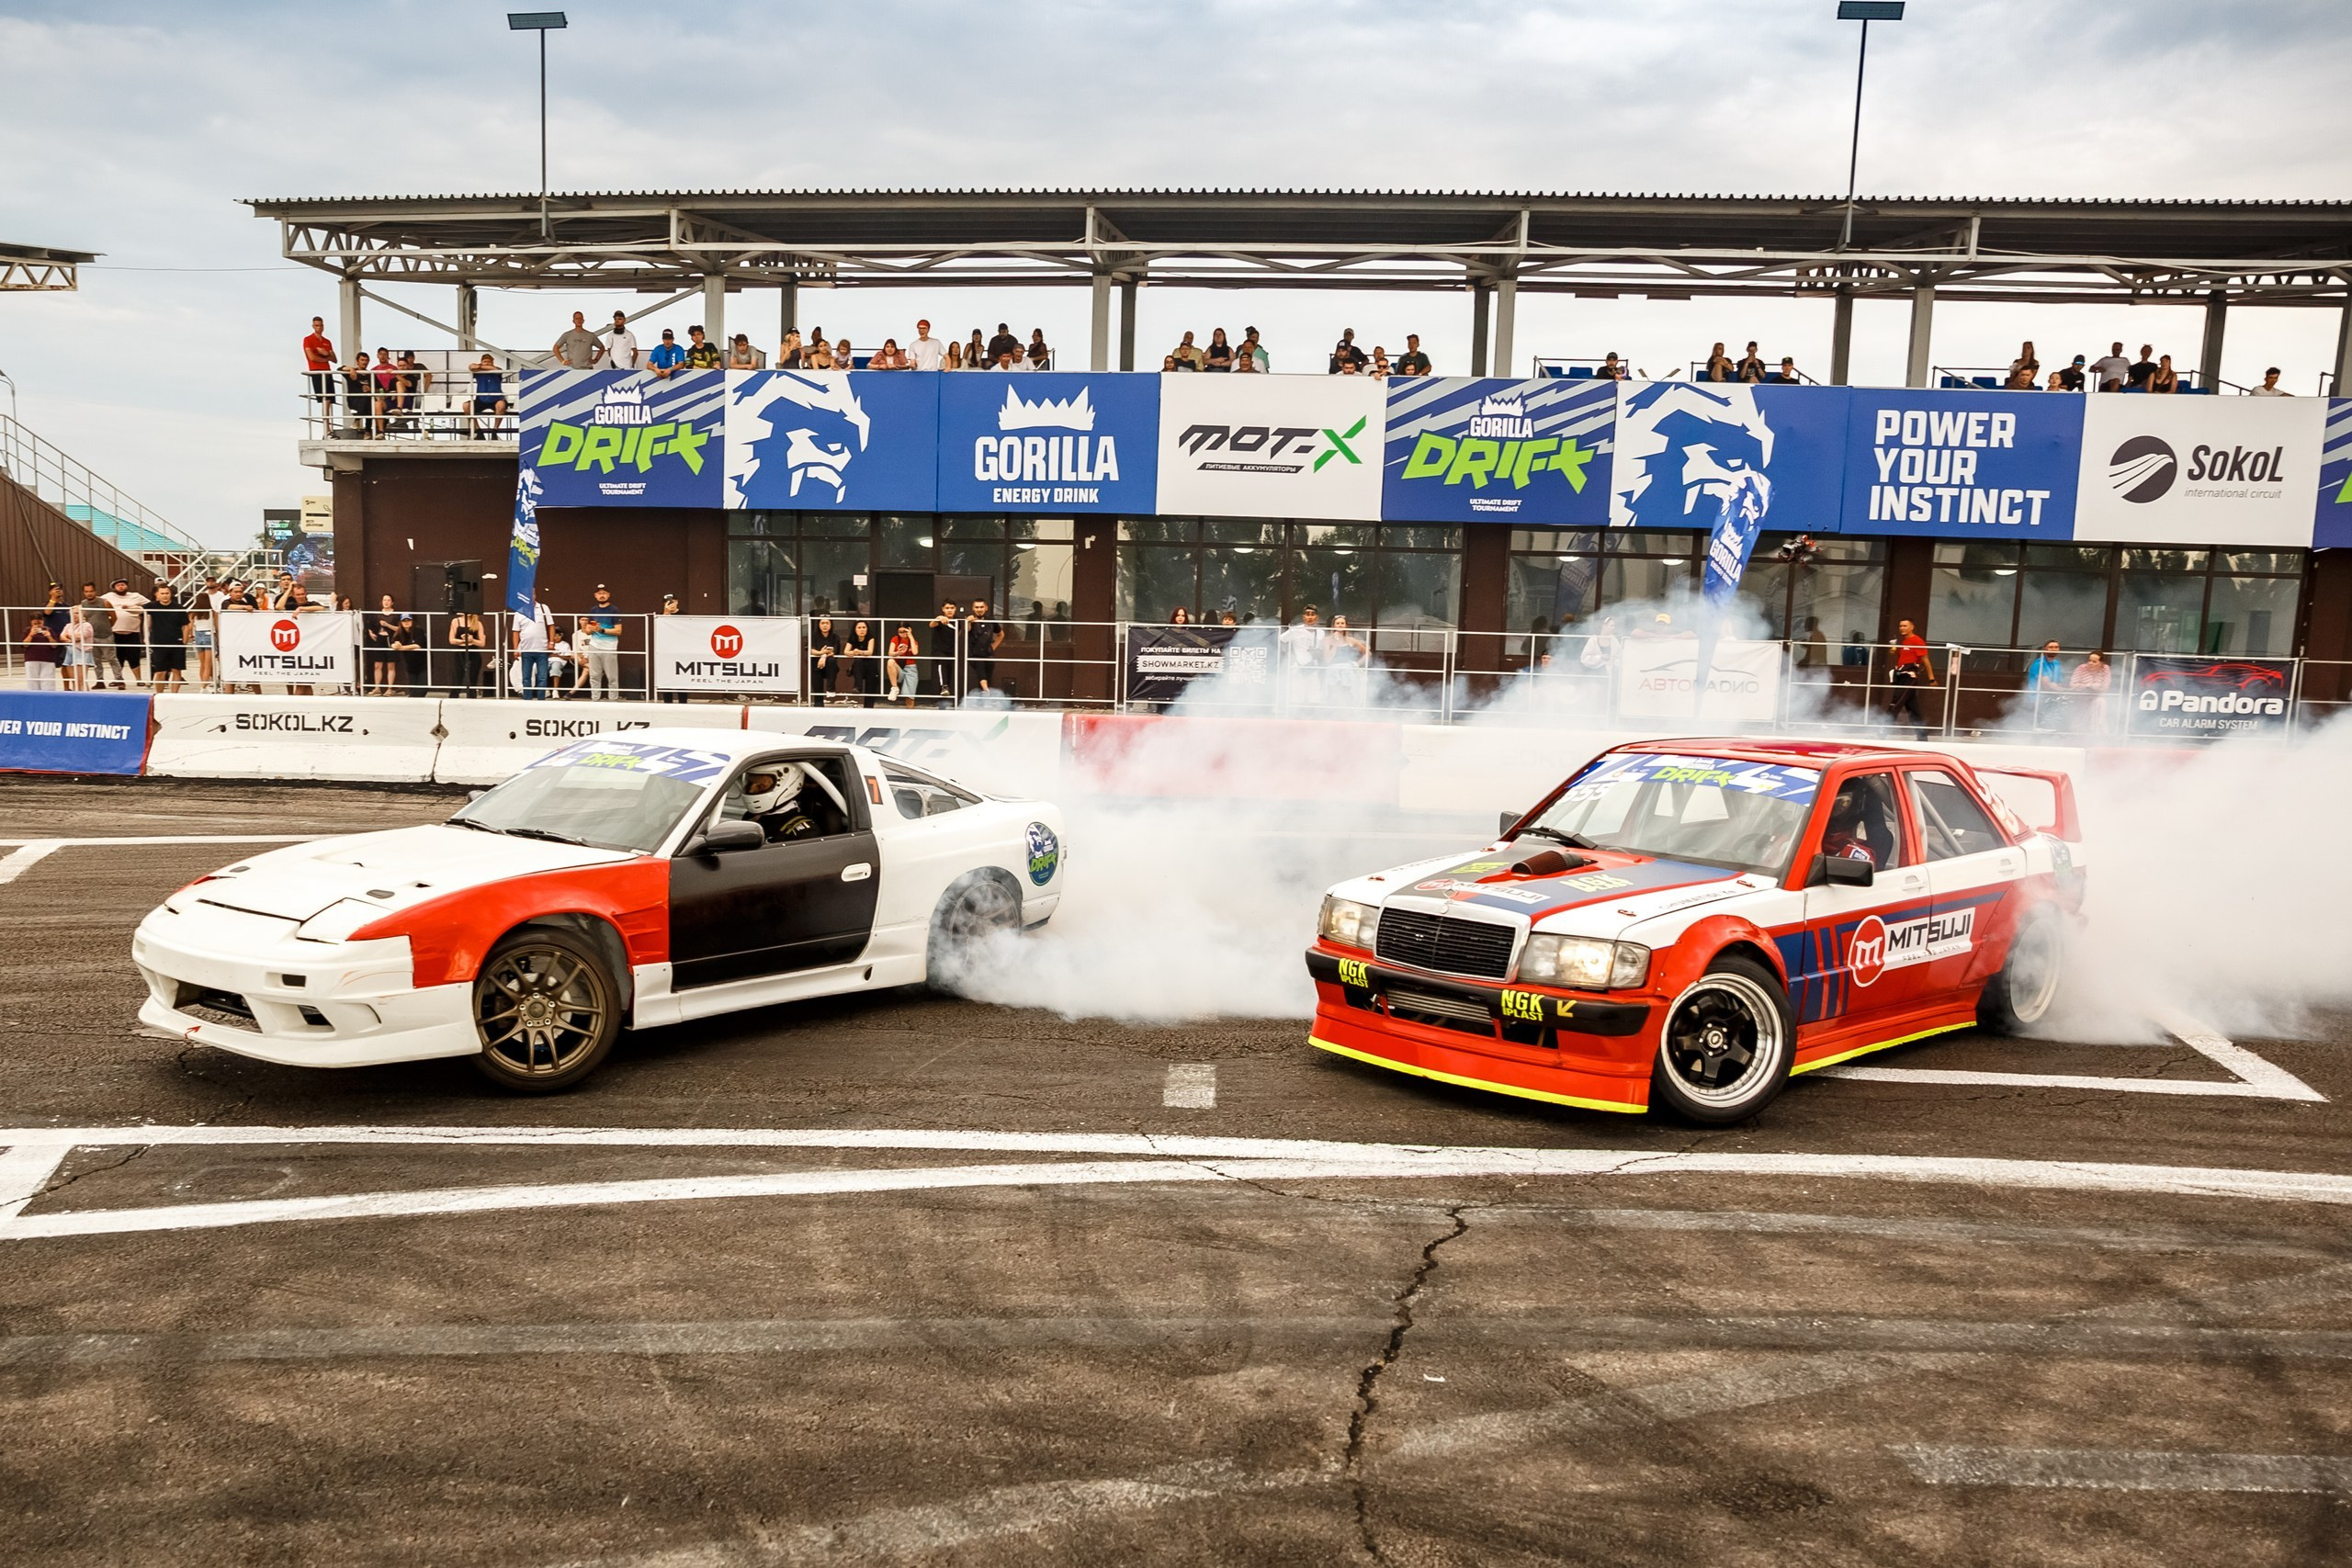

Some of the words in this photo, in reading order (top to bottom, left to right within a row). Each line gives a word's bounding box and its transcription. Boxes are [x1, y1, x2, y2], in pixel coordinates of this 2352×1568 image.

[594, 405, 652, 424] GORILLA
[1470, 417, 1532, 438] GORILLA
[1875, 410, 2017, 448] POWER
[975, 435, 1119, 481] GORILLA
[1873, 447, 1978, 485] YOUR
[1242, 465, 1296, 473] АККУМУЛЯТОРЫ
[993, 488, 1051, 503] ENERGY
[1054, 488, 1099, 503] DRINK
[2184, 488, 2248, 499] international
[2250, 489, 2282, 499] circuit
[1869, 485, 2051, 525] INSTINCT
[1709, 538, 1742, 582] GORILLA
[239, 655, 334, 670] MITSUJI
[675, 660, 779, 677] MITSUJI
[1142, 660, 1219, 669] SHOWMARKET.KZ
[2161, 690, 2283, 715] Pandora
[26, 721, 62, 736] YOUR
[65, 723, 130, 739] INSTINCT
[236, 713, 353, 733] SOKOL.KZ
[526, 719, 650, 738] SOKOK
[2159, 717, 2179, 728] CAR
[2181, 719, 2217, 729] ALARM
[2218, 720, 2258, 730] SYSTEM
[1888, 914, 1971, 952] MITSUJI
[1339, 958, 1370, 980] NGK
[1501, 989, 1544, 1013] NGK
